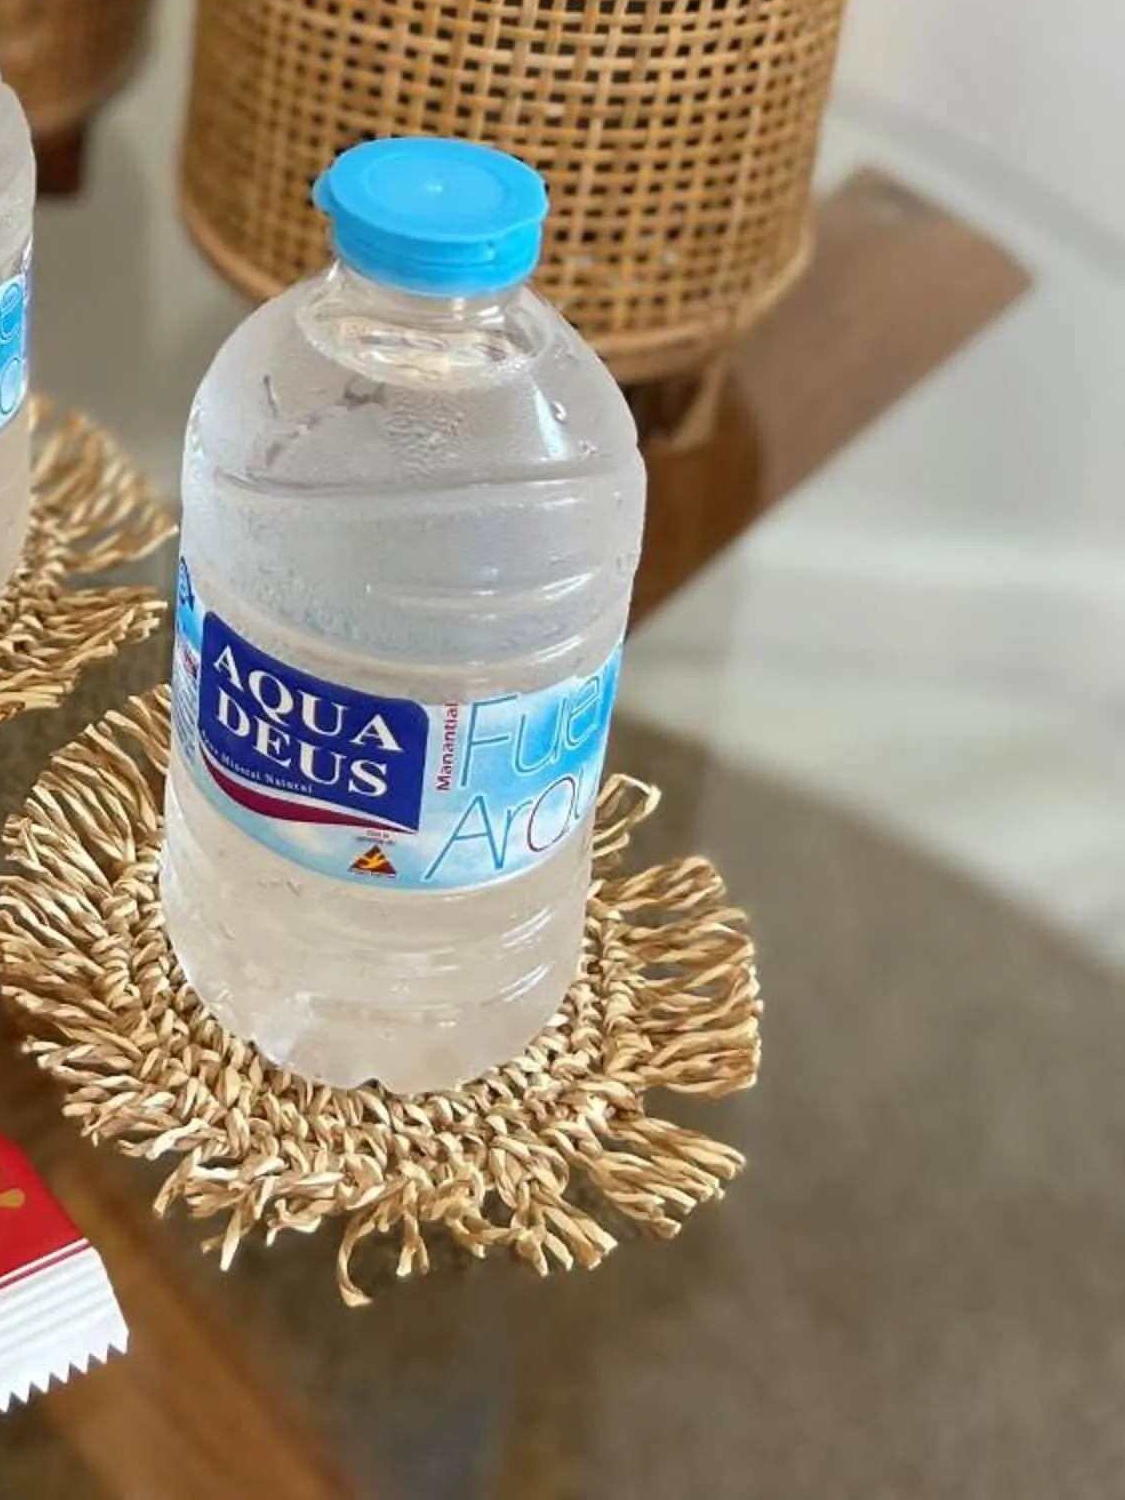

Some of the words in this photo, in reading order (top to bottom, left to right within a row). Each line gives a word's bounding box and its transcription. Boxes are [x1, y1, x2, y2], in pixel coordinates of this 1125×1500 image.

[213, 644, 403, 753] AQUA
[217, 687, 388, 798] DEUS
[436, 703, 458, 791] Manantial
[460, 666, 609, 787] Fue
